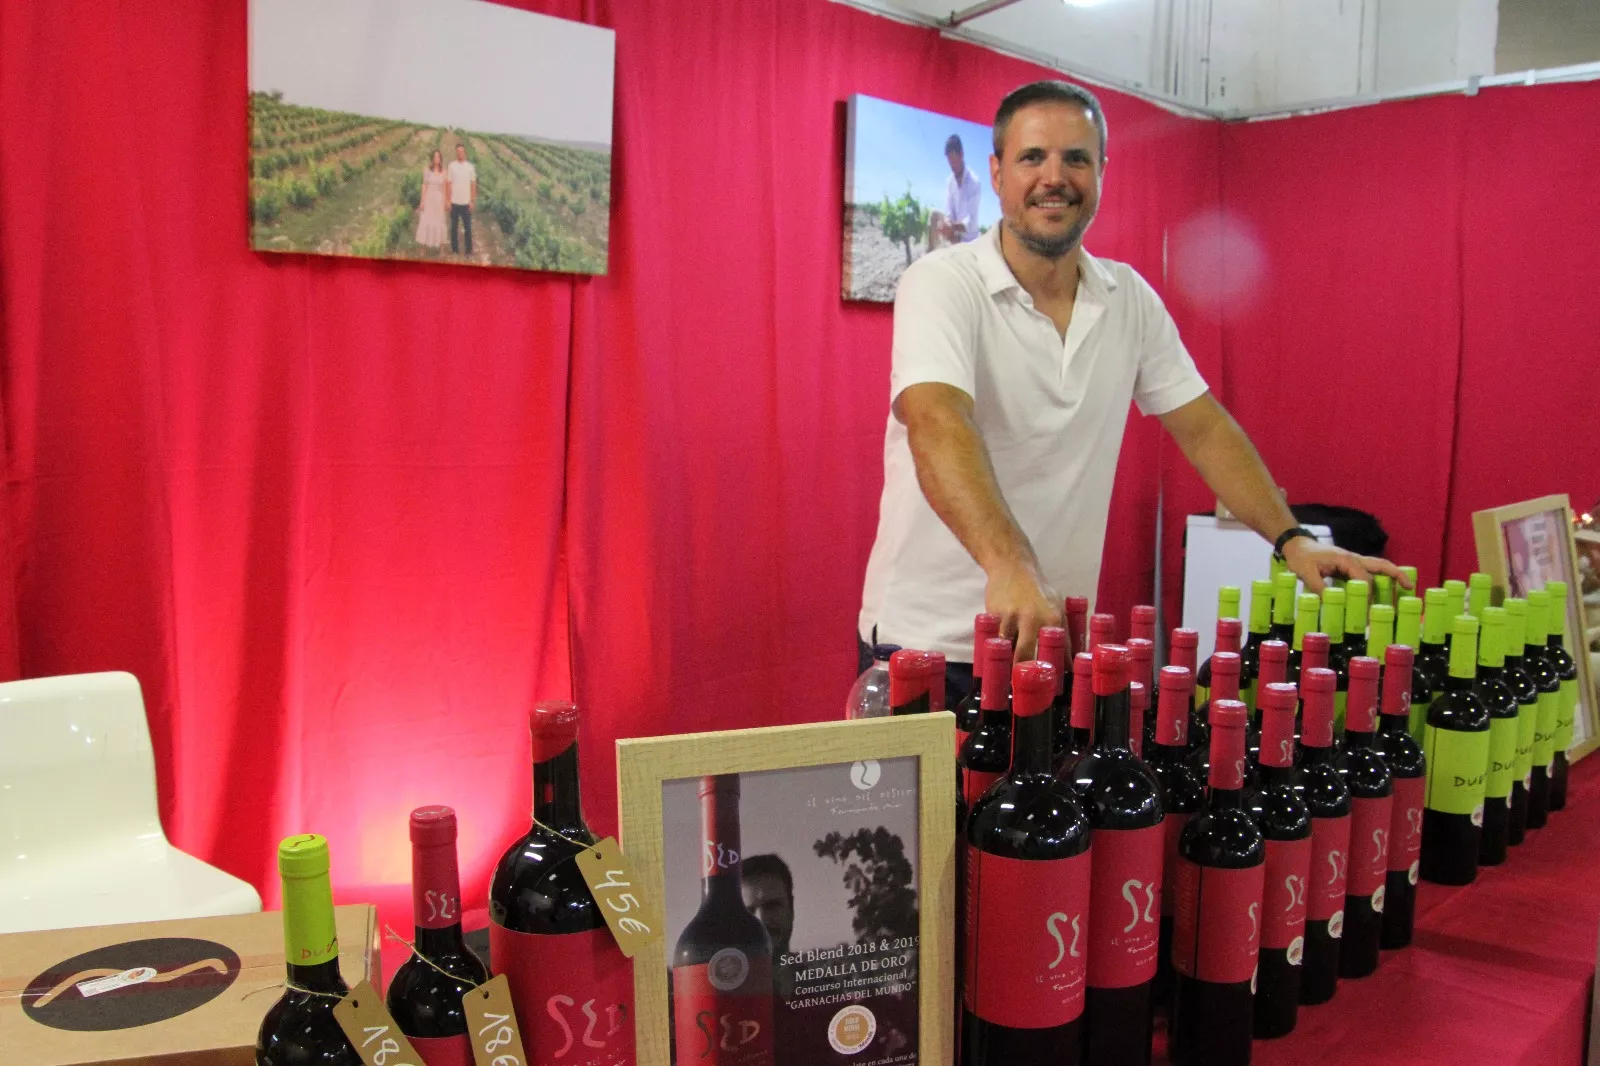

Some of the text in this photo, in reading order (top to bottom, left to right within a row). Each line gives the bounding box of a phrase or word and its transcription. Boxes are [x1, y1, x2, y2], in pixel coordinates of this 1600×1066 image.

[704, 839, 739, 872] SED
[594, 869, 650, 934] 45€
[1122, 879, 1155, 933] SE
[780, 951, 803, 966] Sed
[806, 944, 843, 962] Blend
[847, 942, 876, 956] 2018
[880, 938, 889, 951] &
[1047, 912, 1081, 969] SE
[795, 955, 907, 982] MEDALLA DE ORO
[795, 969, 907, 996] Concurso Internacional
[785, 991, 852, 1010] "GARNACHAS
[854, 989, 872, 1000] DEL
[875, 980, 917, 997] MUNDO"
[361, 1026, 414, 1066] 18
[695, 1011, 760, 1058] SED
